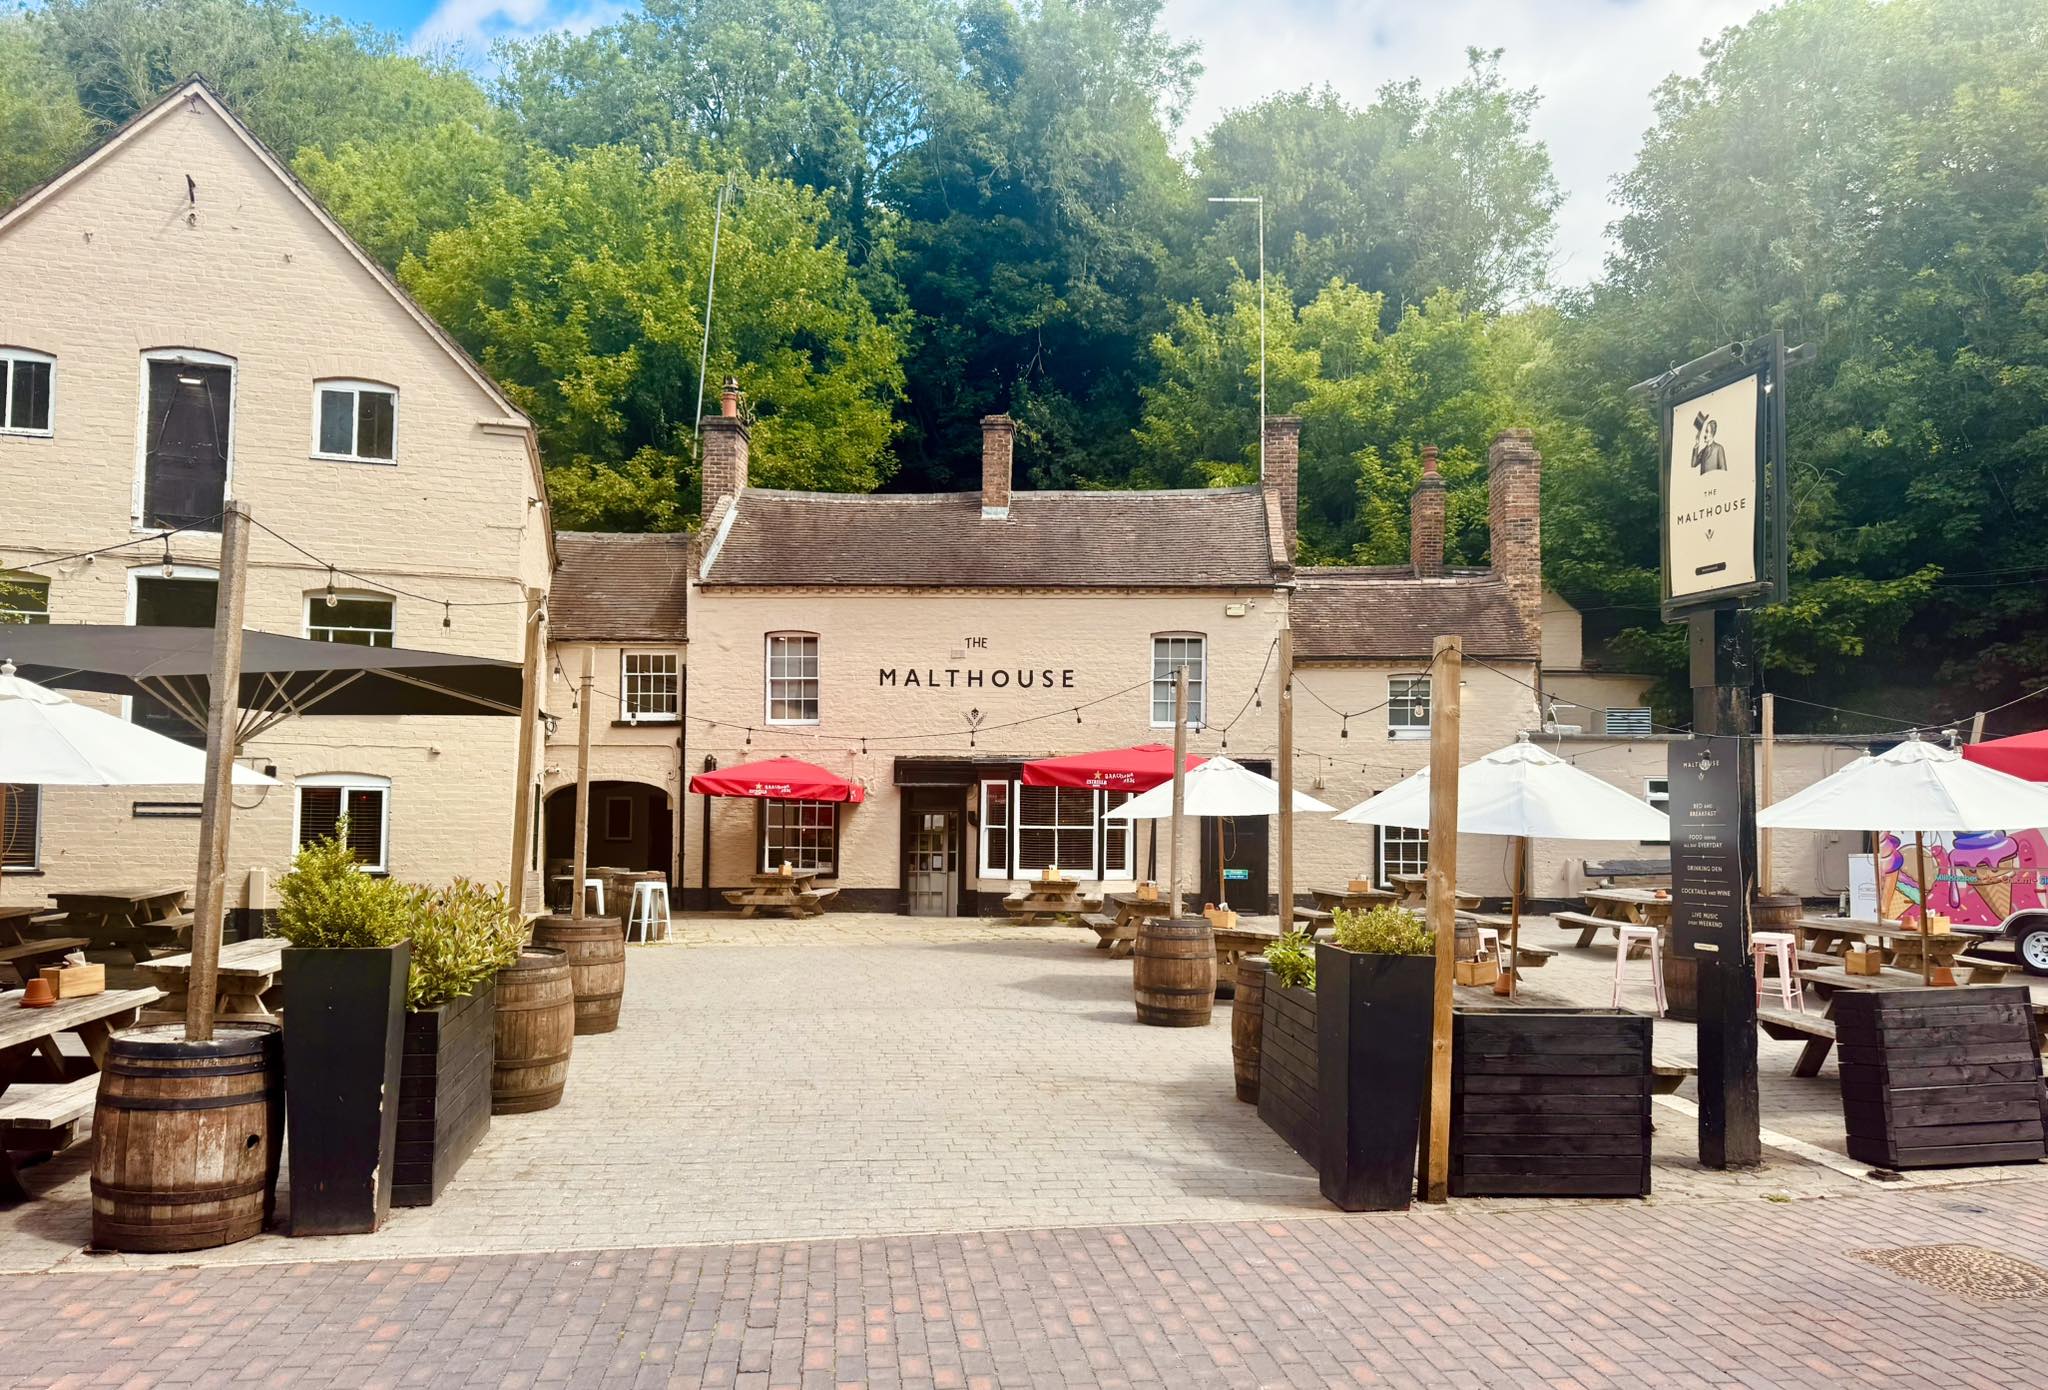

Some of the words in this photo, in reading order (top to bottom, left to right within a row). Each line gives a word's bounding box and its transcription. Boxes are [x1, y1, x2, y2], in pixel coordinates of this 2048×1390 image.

[1677, 498, 1746, 525] MALTHOUSE
[964, 637, 988, 649] THE
[879, 668, 1074, 688] MALTHOUSE
[1699, 920, 1723, 928] WEEKEND
